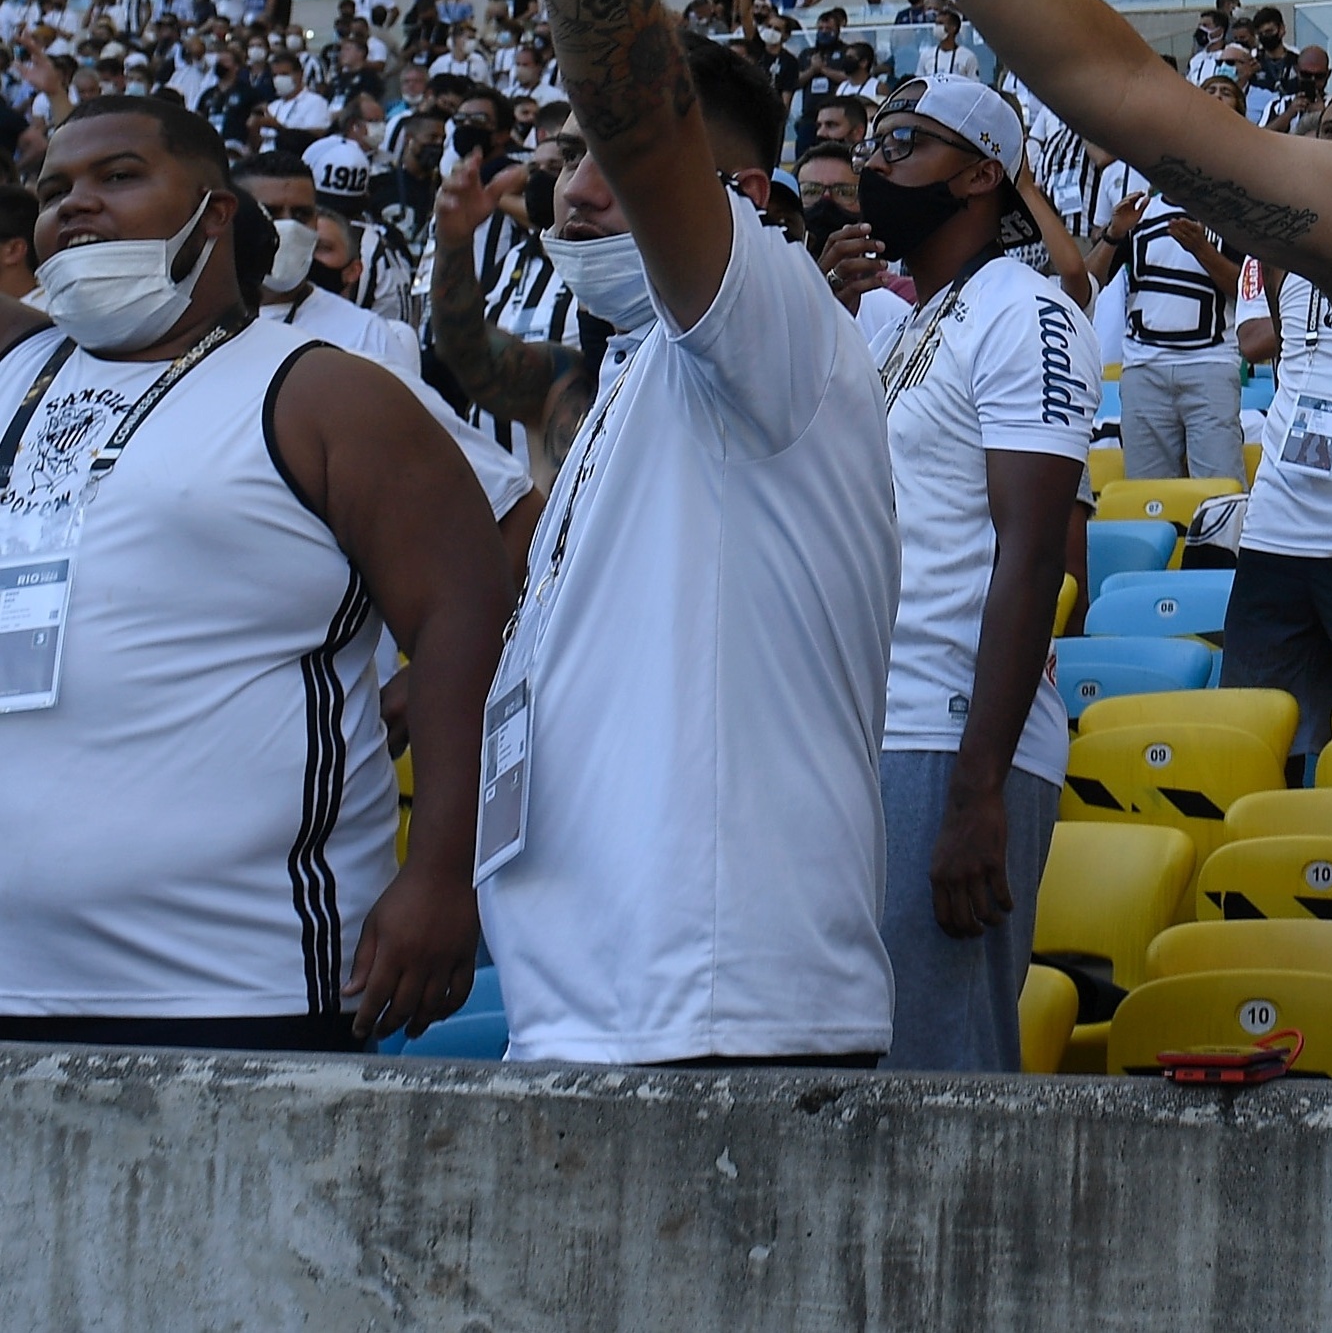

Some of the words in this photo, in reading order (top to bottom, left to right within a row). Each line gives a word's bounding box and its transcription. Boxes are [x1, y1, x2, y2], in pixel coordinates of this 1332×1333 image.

[114, 385, 166, 445] CONMEBOL
[161, 325, 228, 390] LIBERTADORES
[1160, 602, 1174, 613] 08
[1081, 685, 1096, 697] 08
[1150, 748, 1167, 762] 09
[1312, 867, 1331, 882] 10
[1248, 1007, 1270, 1025] 10
